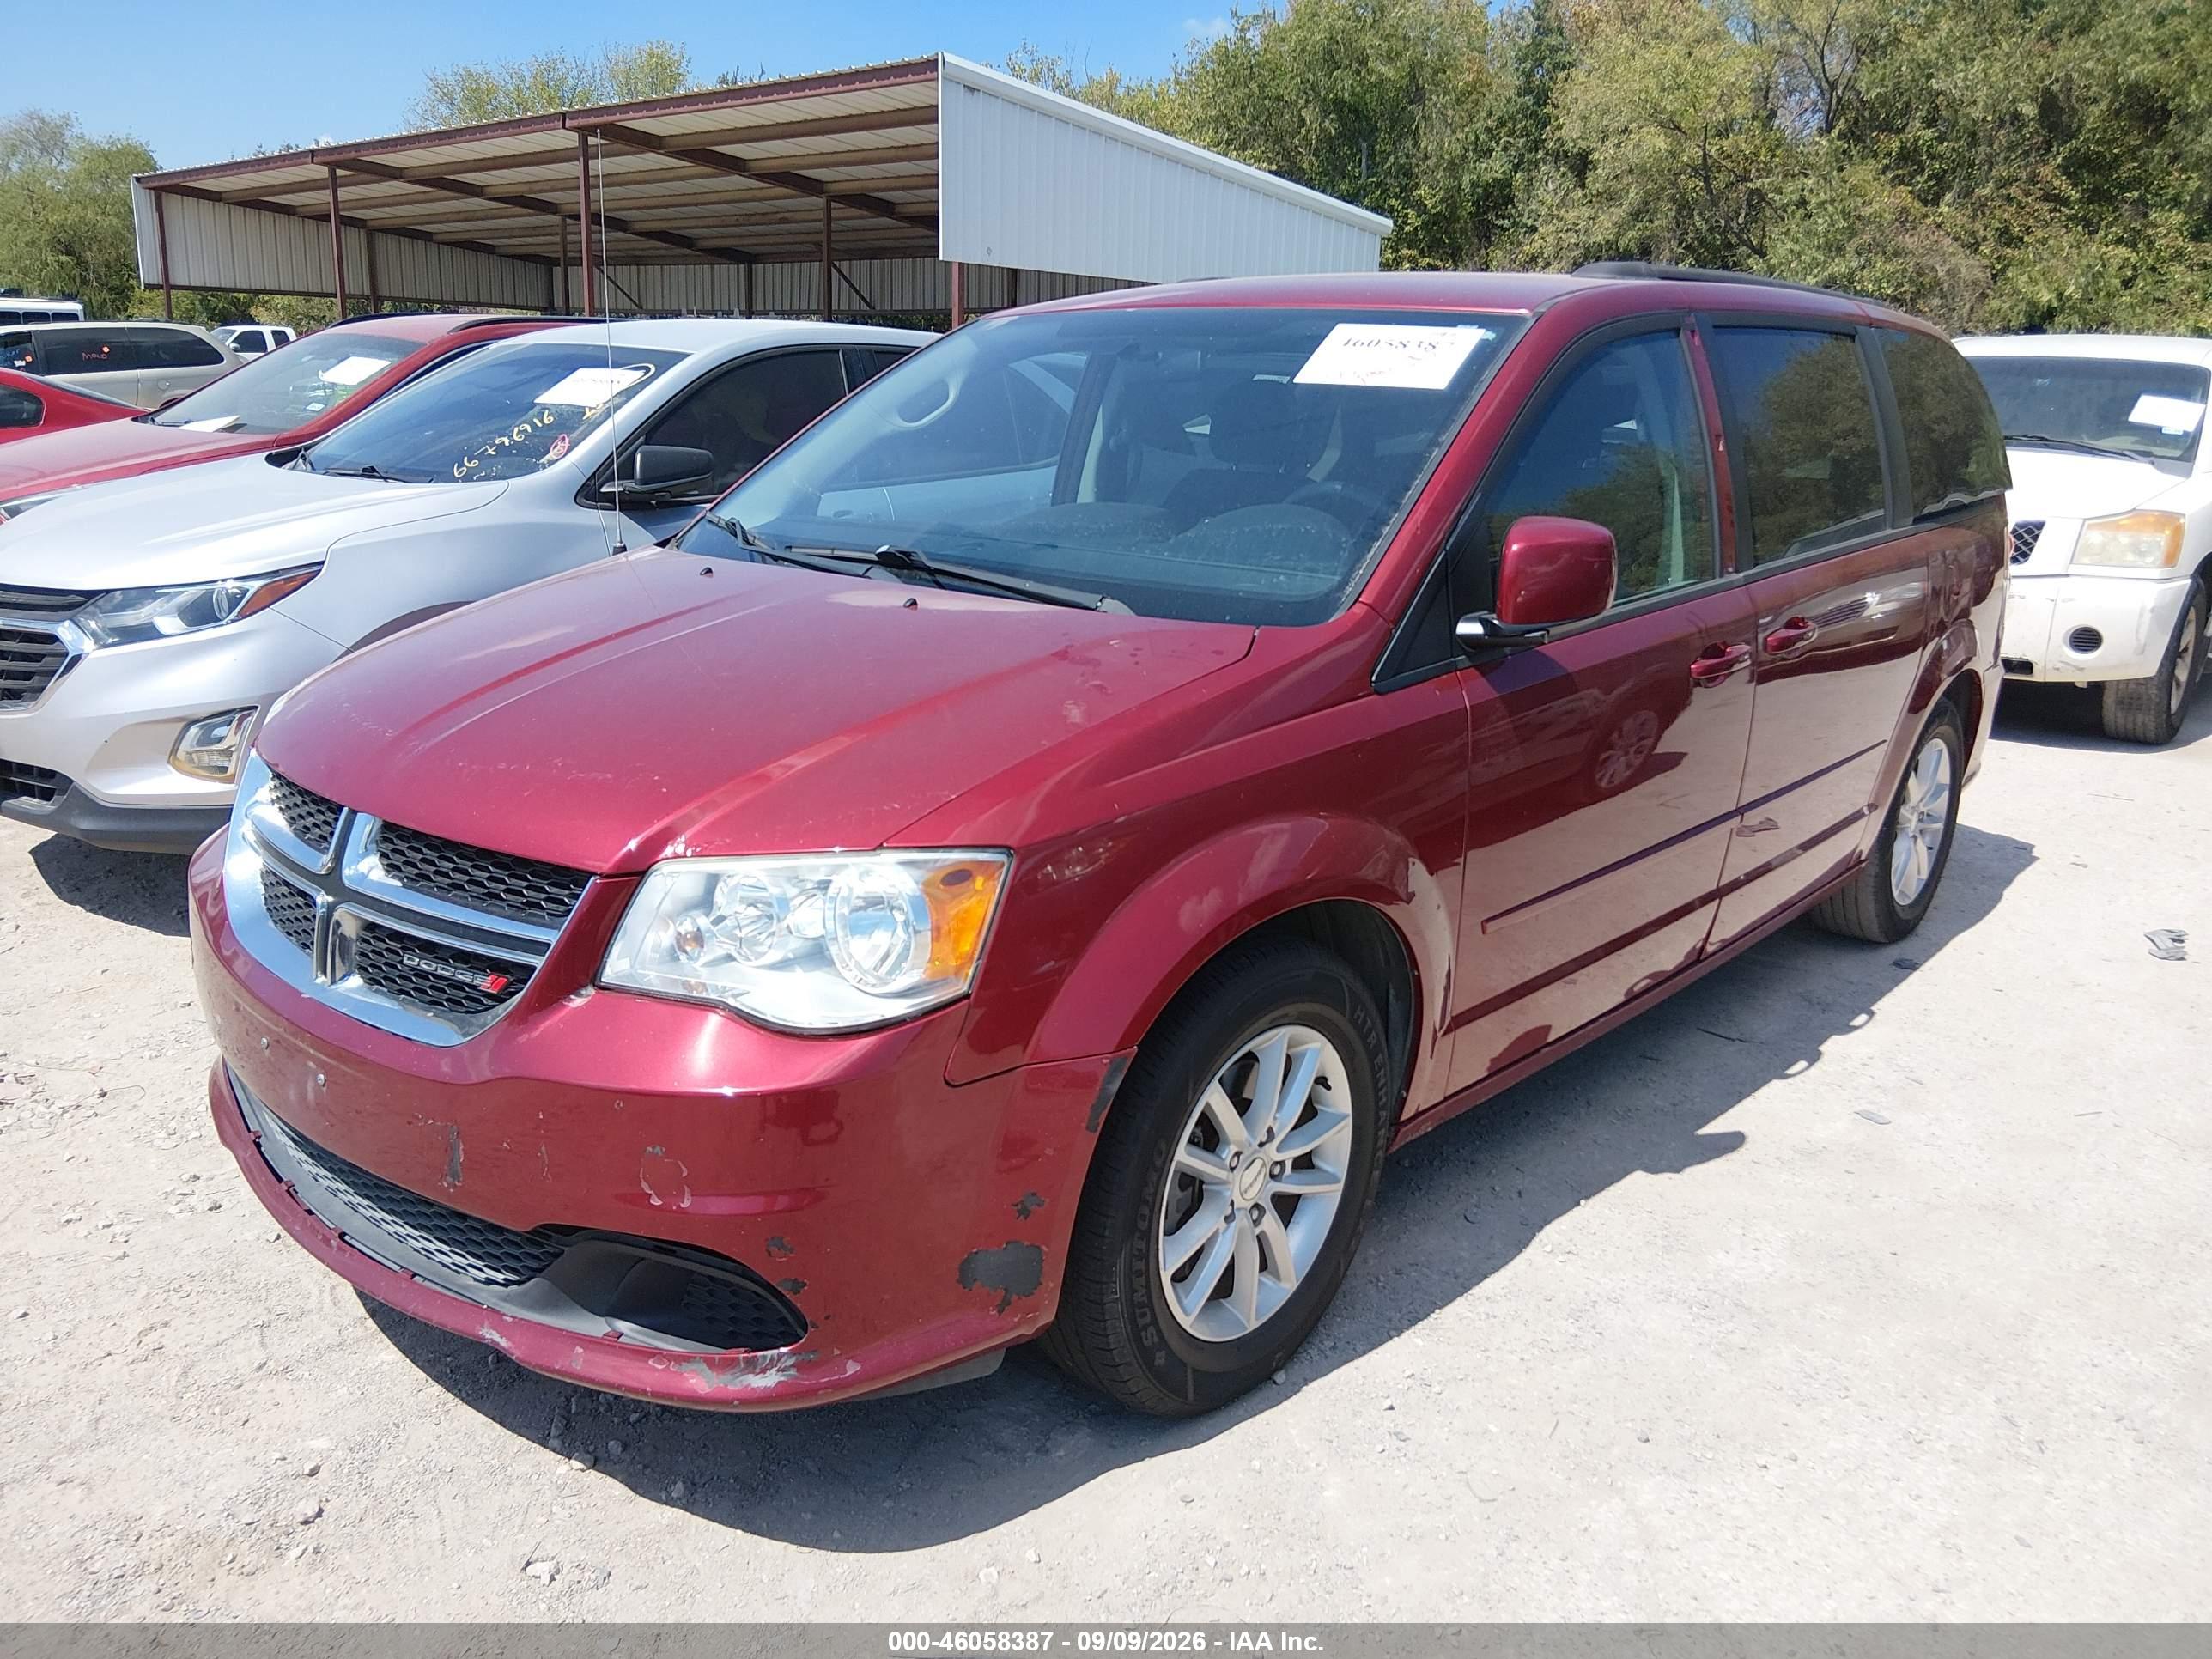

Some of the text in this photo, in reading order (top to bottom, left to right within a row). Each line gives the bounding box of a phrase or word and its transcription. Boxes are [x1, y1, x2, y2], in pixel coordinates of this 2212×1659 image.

[402, 952, 493, 987] DODGE
[1352, 1004, 1378, 1048] HTR
[1131, 1138, 1168, 1348] SUMITOMO
